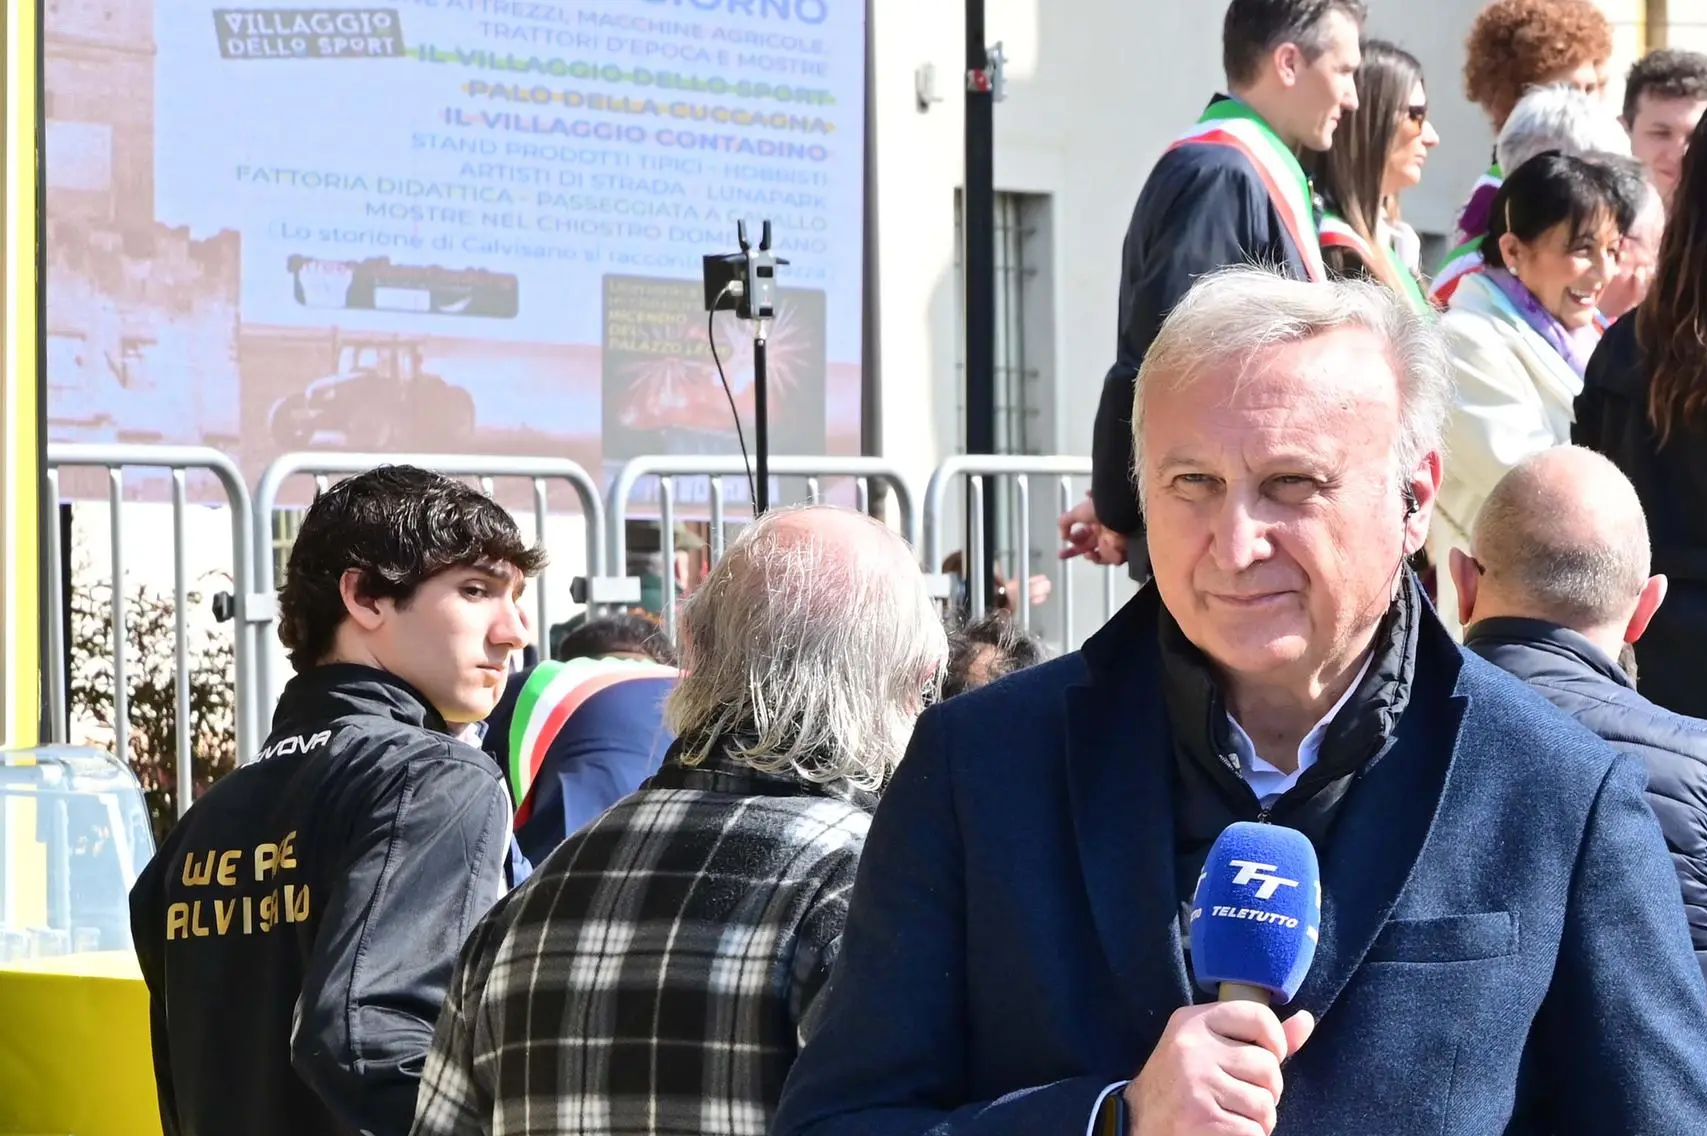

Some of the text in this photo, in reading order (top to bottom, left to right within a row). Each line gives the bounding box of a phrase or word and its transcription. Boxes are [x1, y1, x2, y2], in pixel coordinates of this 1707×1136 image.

[223, 12, 392, 35] VILLAGGIO
[226, 36, 395, 57] DELLO SPORT
[576, 10, 702, 40] MACCHINE
[479, 21, 828, 77] TRATTORI D'EPOCA E MOSTRE
[417, 43, 833, 106] IL VILLAGGIO DELLO SPORT
[467, 78, 830, 134] PALO DELLA CUCCAGNA
[411, 131, 828, 186] STAND PRODOTTI TIPICI HOBBISTI
[443, 106, 829, 162] IL VILLAGGIO CONTADINO
[235, 164, 829, 232] FATTORIA DIDATTICA PASSEGGIATA A CAVALLO
[459, 161, 829, 211] ARTISTI DI STRADA LUNAPARK
[365, 201, 829, 254] MOSTRE NEL CHIOSTRO DOMEANO
[431, 232, 455, 251] di
[461, 235, 577, 261] Calvisano
[182, 850, 242, 887] WE
[1229, 859, 1299, 900] TT
[1211, 905, 1299, 929] TELETUTTO
